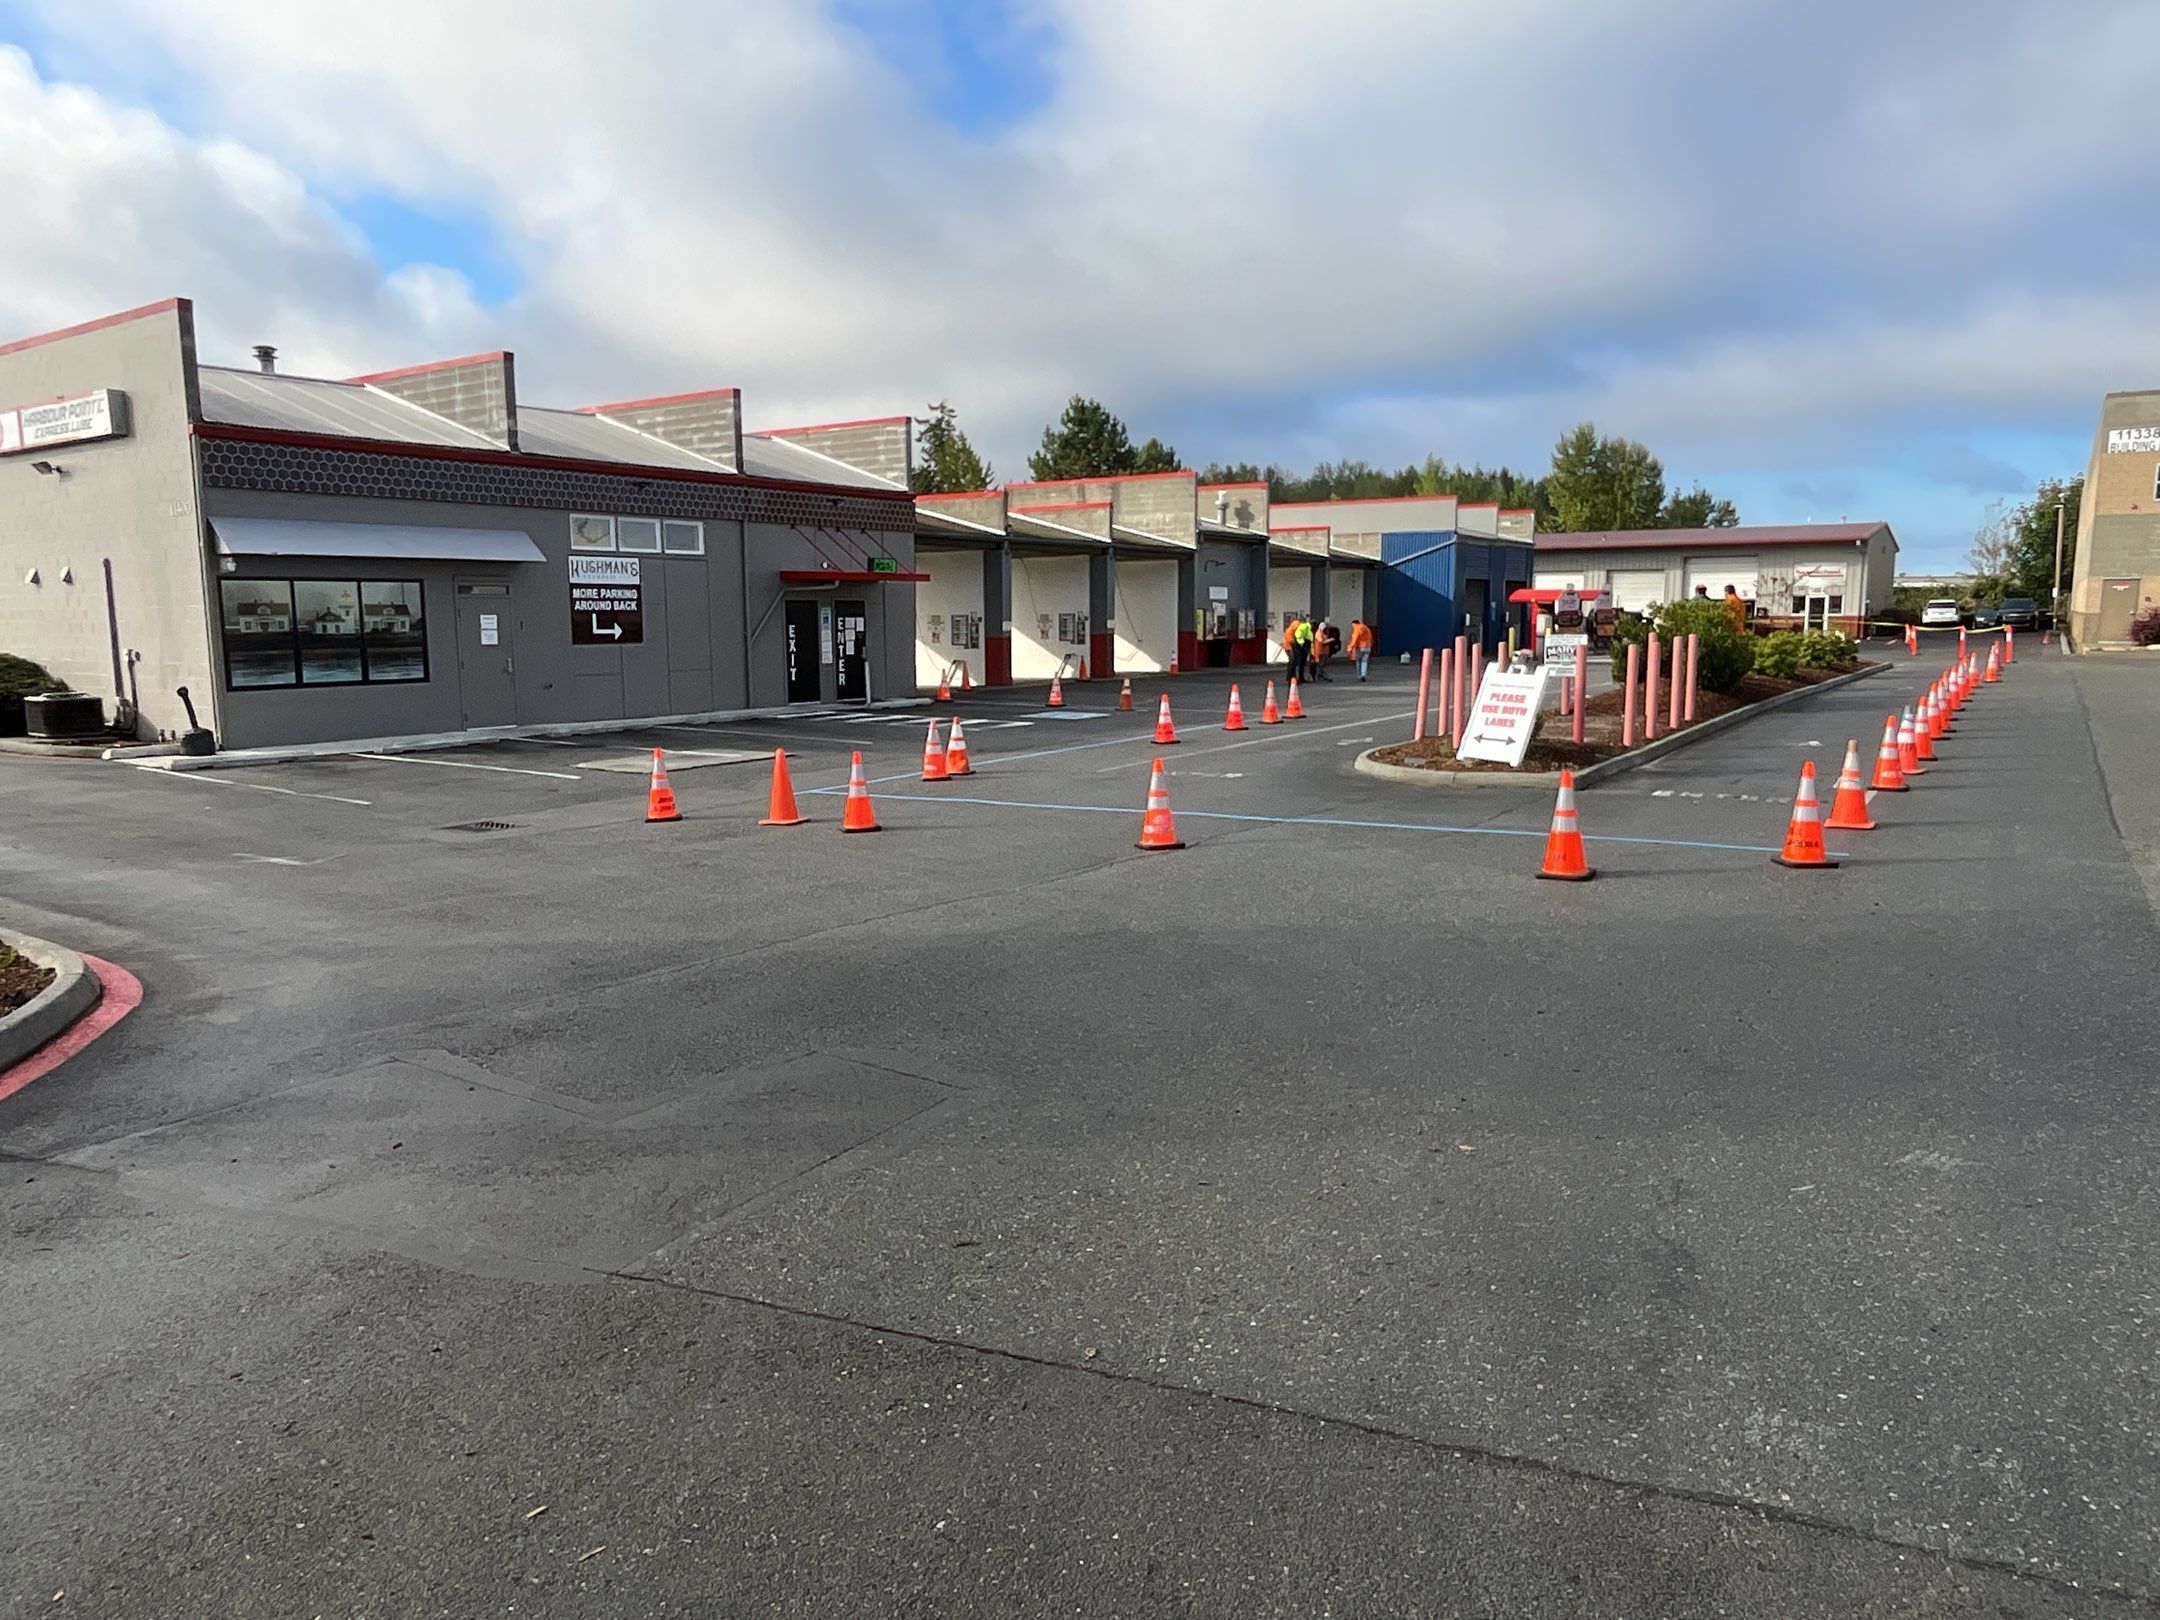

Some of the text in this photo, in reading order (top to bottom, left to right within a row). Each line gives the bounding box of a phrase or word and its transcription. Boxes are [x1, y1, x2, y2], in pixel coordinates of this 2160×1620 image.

[2116, 429, 2160, 440] 11338
[570, 559, 639, 578] KUSHMAN'S
[572, 588, 638, 599] MORE PARKING
[574, 600, 638, 611] AROUND BACK
[788, 624, 797, 681] EXIT
[837, 617, 846, 686] ENTER
[1489, 692, 1527, 704] PLEASE
[1481, 704, 1528, 716] USE BOTH
[1484, 717, 1516, 728] LANES
